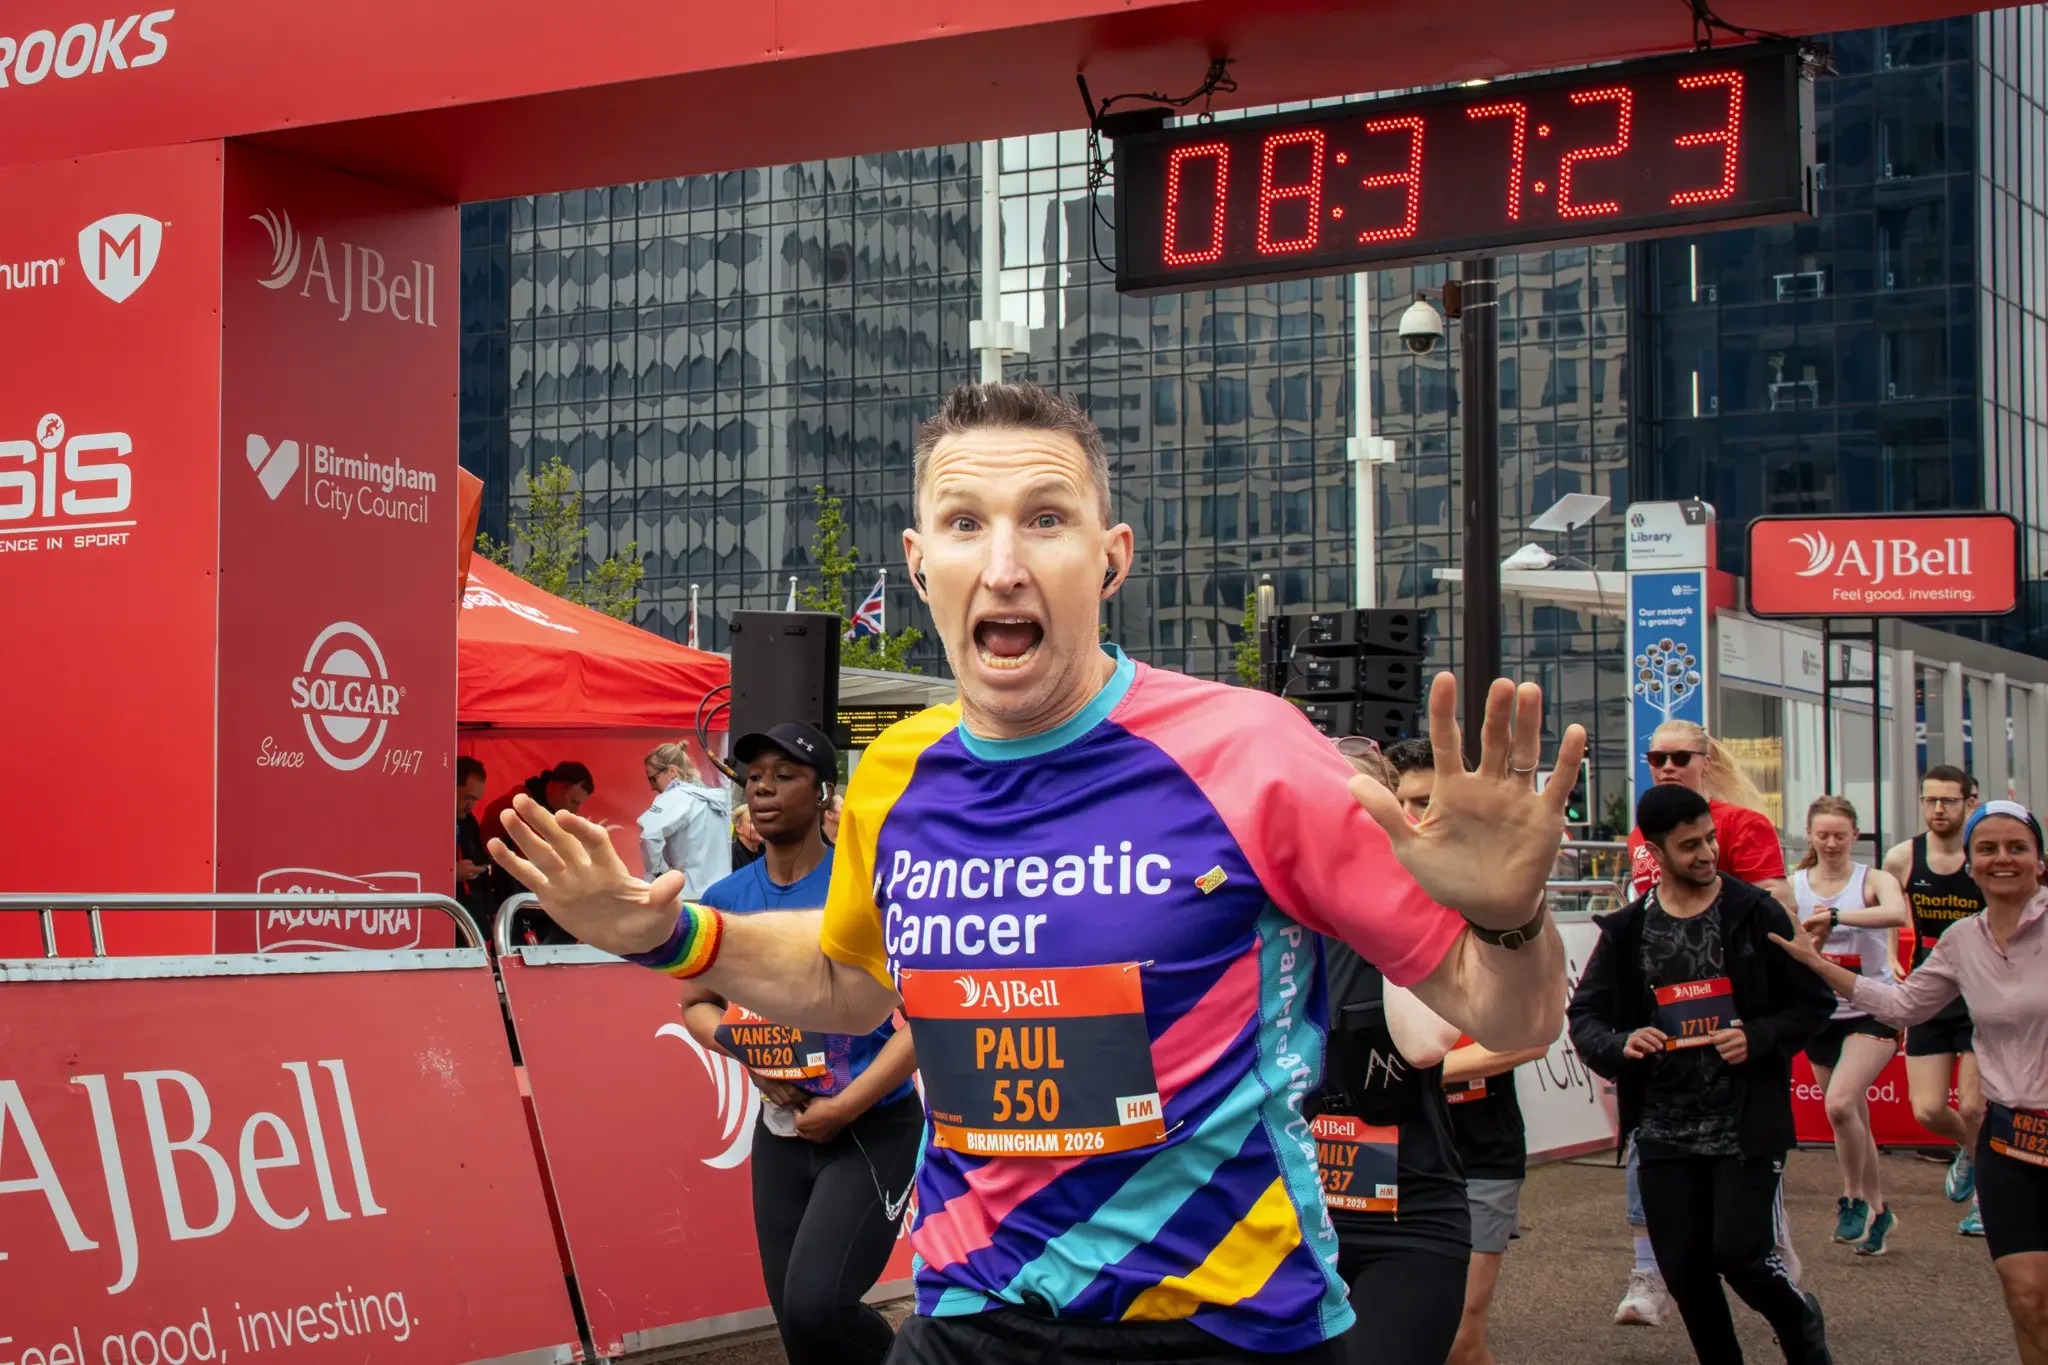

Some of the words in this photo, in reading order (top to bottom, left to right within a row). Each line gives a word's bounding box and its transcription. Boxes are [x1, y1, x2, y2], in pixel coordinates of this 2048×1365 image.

[314, 444, 436, 493] Birmingham
[314, 479, 354, 520] City
[357, 486, 428, 524] Council
[47, 537, 63, 549] IN
[74, 533, 130, 548] SPORT
[1630, 531, 1672, 544] Library
[1833, 588, 1861, 601] Feel
[1864, 588, 1905, 603] good,
[1909, 588, 1975, 602] investing.
[1638, 608, 1656, 617] Our
[1657, 606, 1693, 615] network
[1638, 618, 1646, 627] is
[1648, 616, 1686, 628] growing!
[291, 676, 400, 715] SOLGAR
[256, 736, 305, 769] Since
[382, 748, 423, 776] 1947
[885, 839, 1172, 900] Pancreatic
[1912, 893, 1979, 909] Chorlton
[884, 902, 1048, 956] Cancer
[730, 1025, 803, 1046] VANESSA
[1681, 1016, 1720, 1036] 17117
[746, 1047, 794, 1066] 11620
[975, 1025, 1065, 1070] PAUL
[992, 1078, 1060, 1123] 550
[1866, 1080, 1901, 1104] od,
[1126, 1100, 1153, 1118] HM
[966, 1131, 1059, 1152] BIRMINGHAM
[1063, 1131, 1105, 1151] 2026
[1379, 1187, 1394, 1196] HM
[1346, 1197, 1367, 1209] 2026
[0, 1326, 85, 1365] eel
[235, 1285, 419, 1354] investing.
